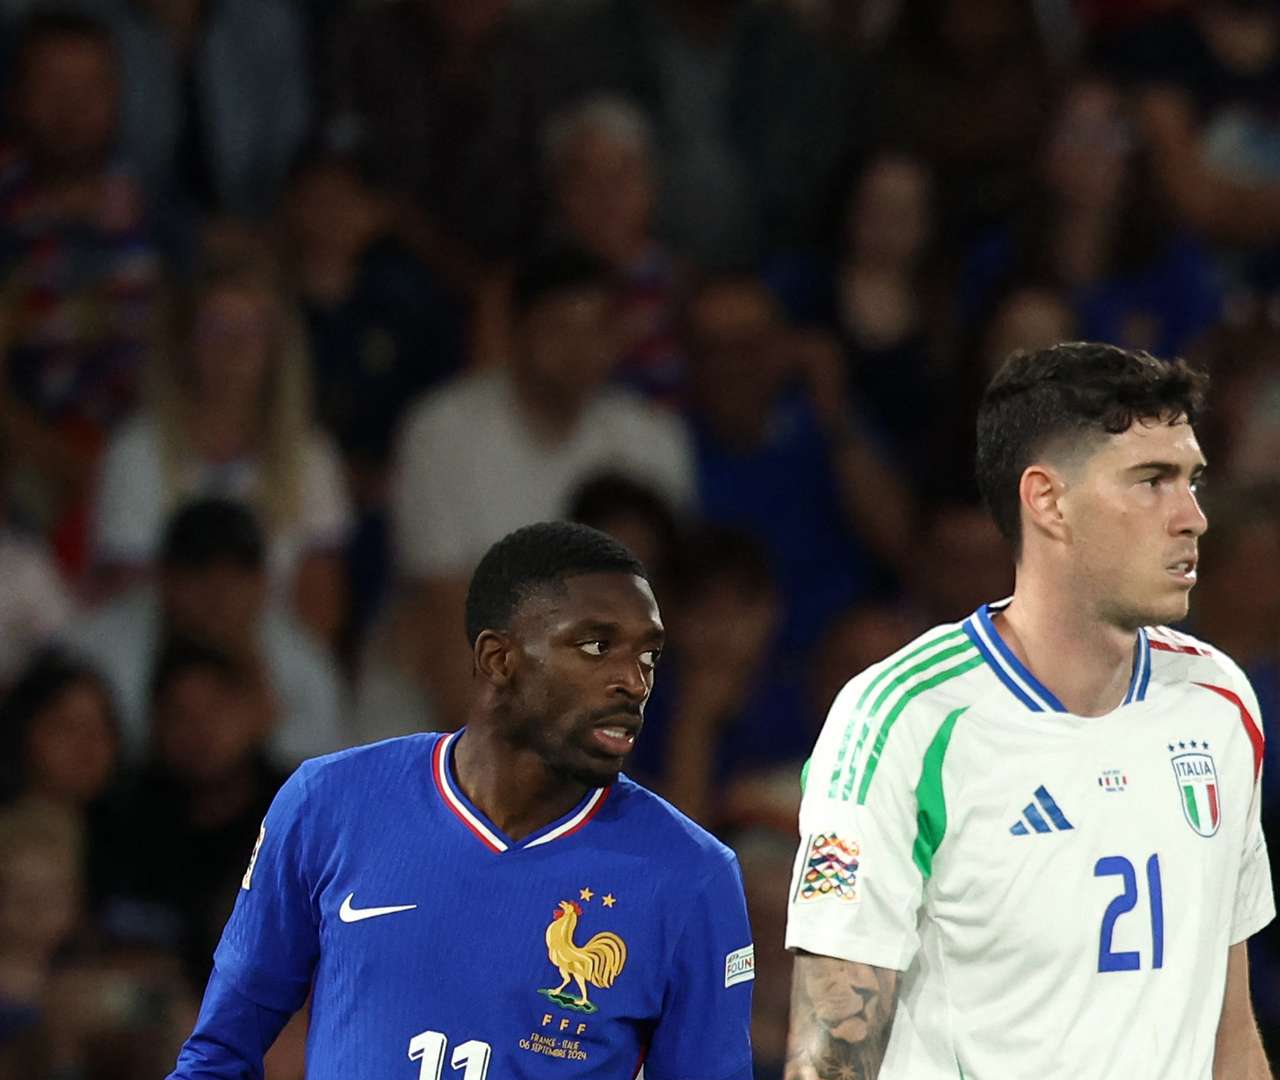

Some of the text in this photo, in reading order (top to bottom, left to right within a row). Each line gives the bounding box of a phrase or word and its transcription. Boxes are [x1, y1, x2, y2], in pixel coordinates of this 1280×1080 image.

[1175, 760, 1213, 777] ITALIA
[1093, 853, 1164, 974] 21
[531, 1032, 557, 1047] FRANCE
[519, 1039, 531, 1050] 06
[567, 1049, 587, 1060] 2024
